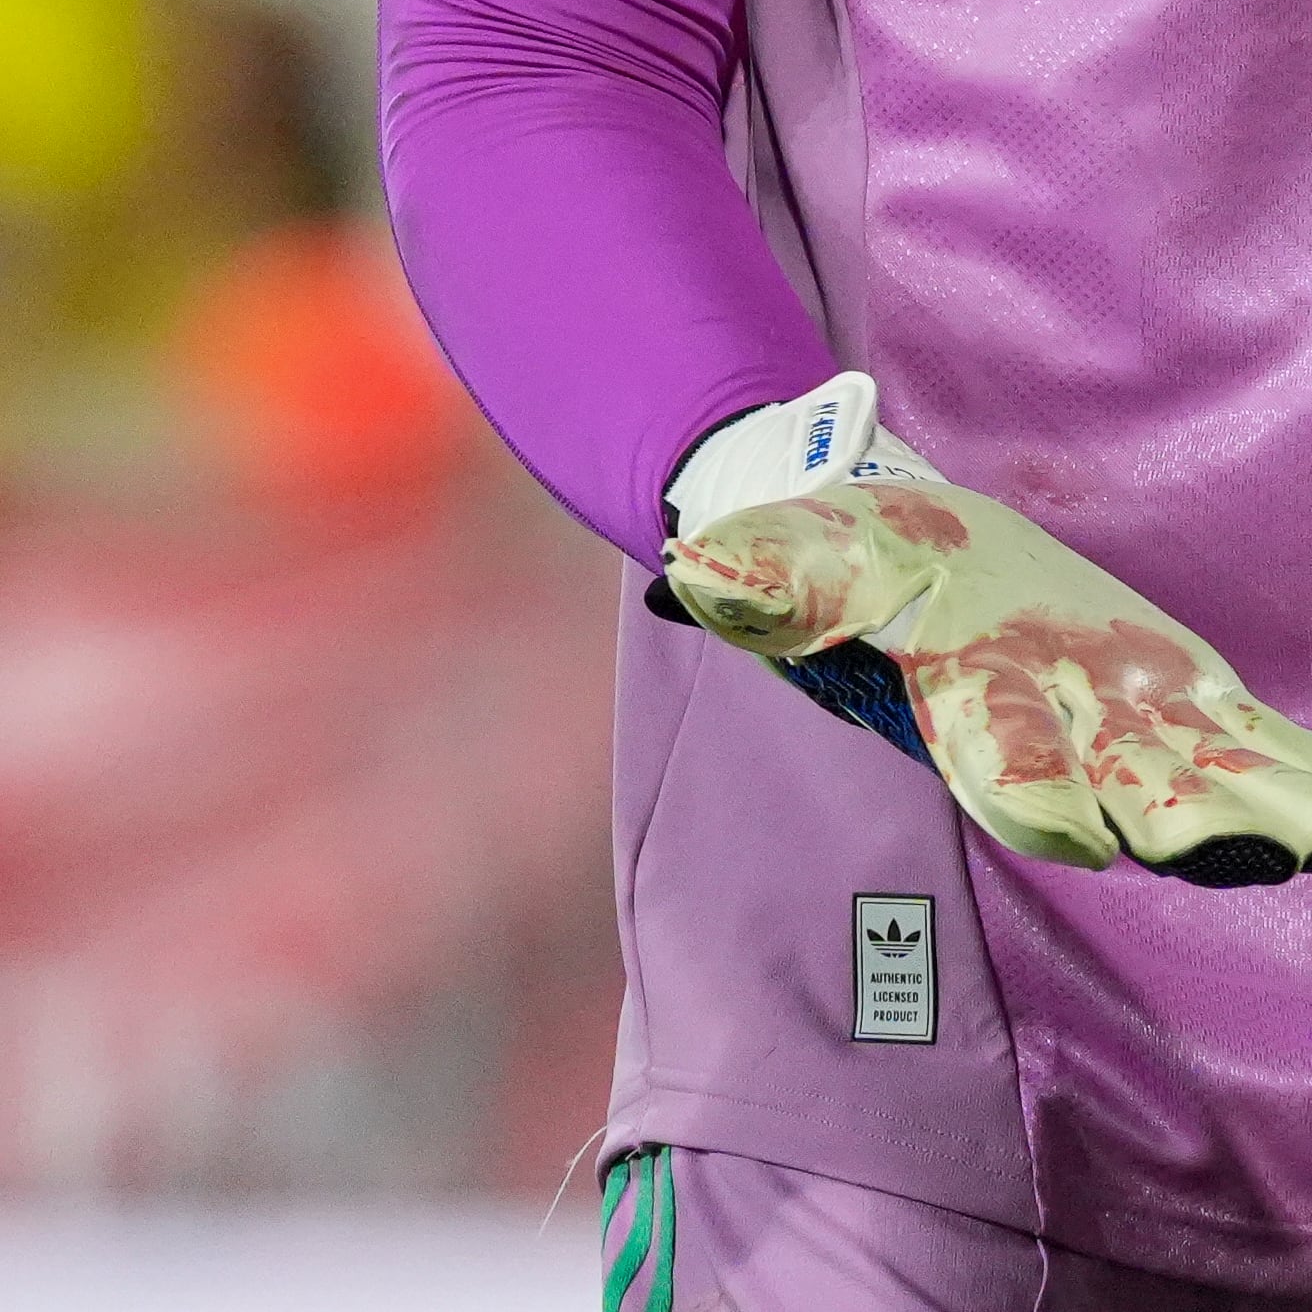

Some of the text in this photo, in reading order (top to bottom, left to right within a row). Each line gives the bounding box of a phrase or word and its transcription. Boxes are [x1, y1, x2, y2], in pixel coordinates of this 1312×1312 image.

[870, 973, 922, 984] AUTHENTIC
[873, 991, 919, 1003] LICENSED
[873, 1010, 918, 1022] PRODUCT
